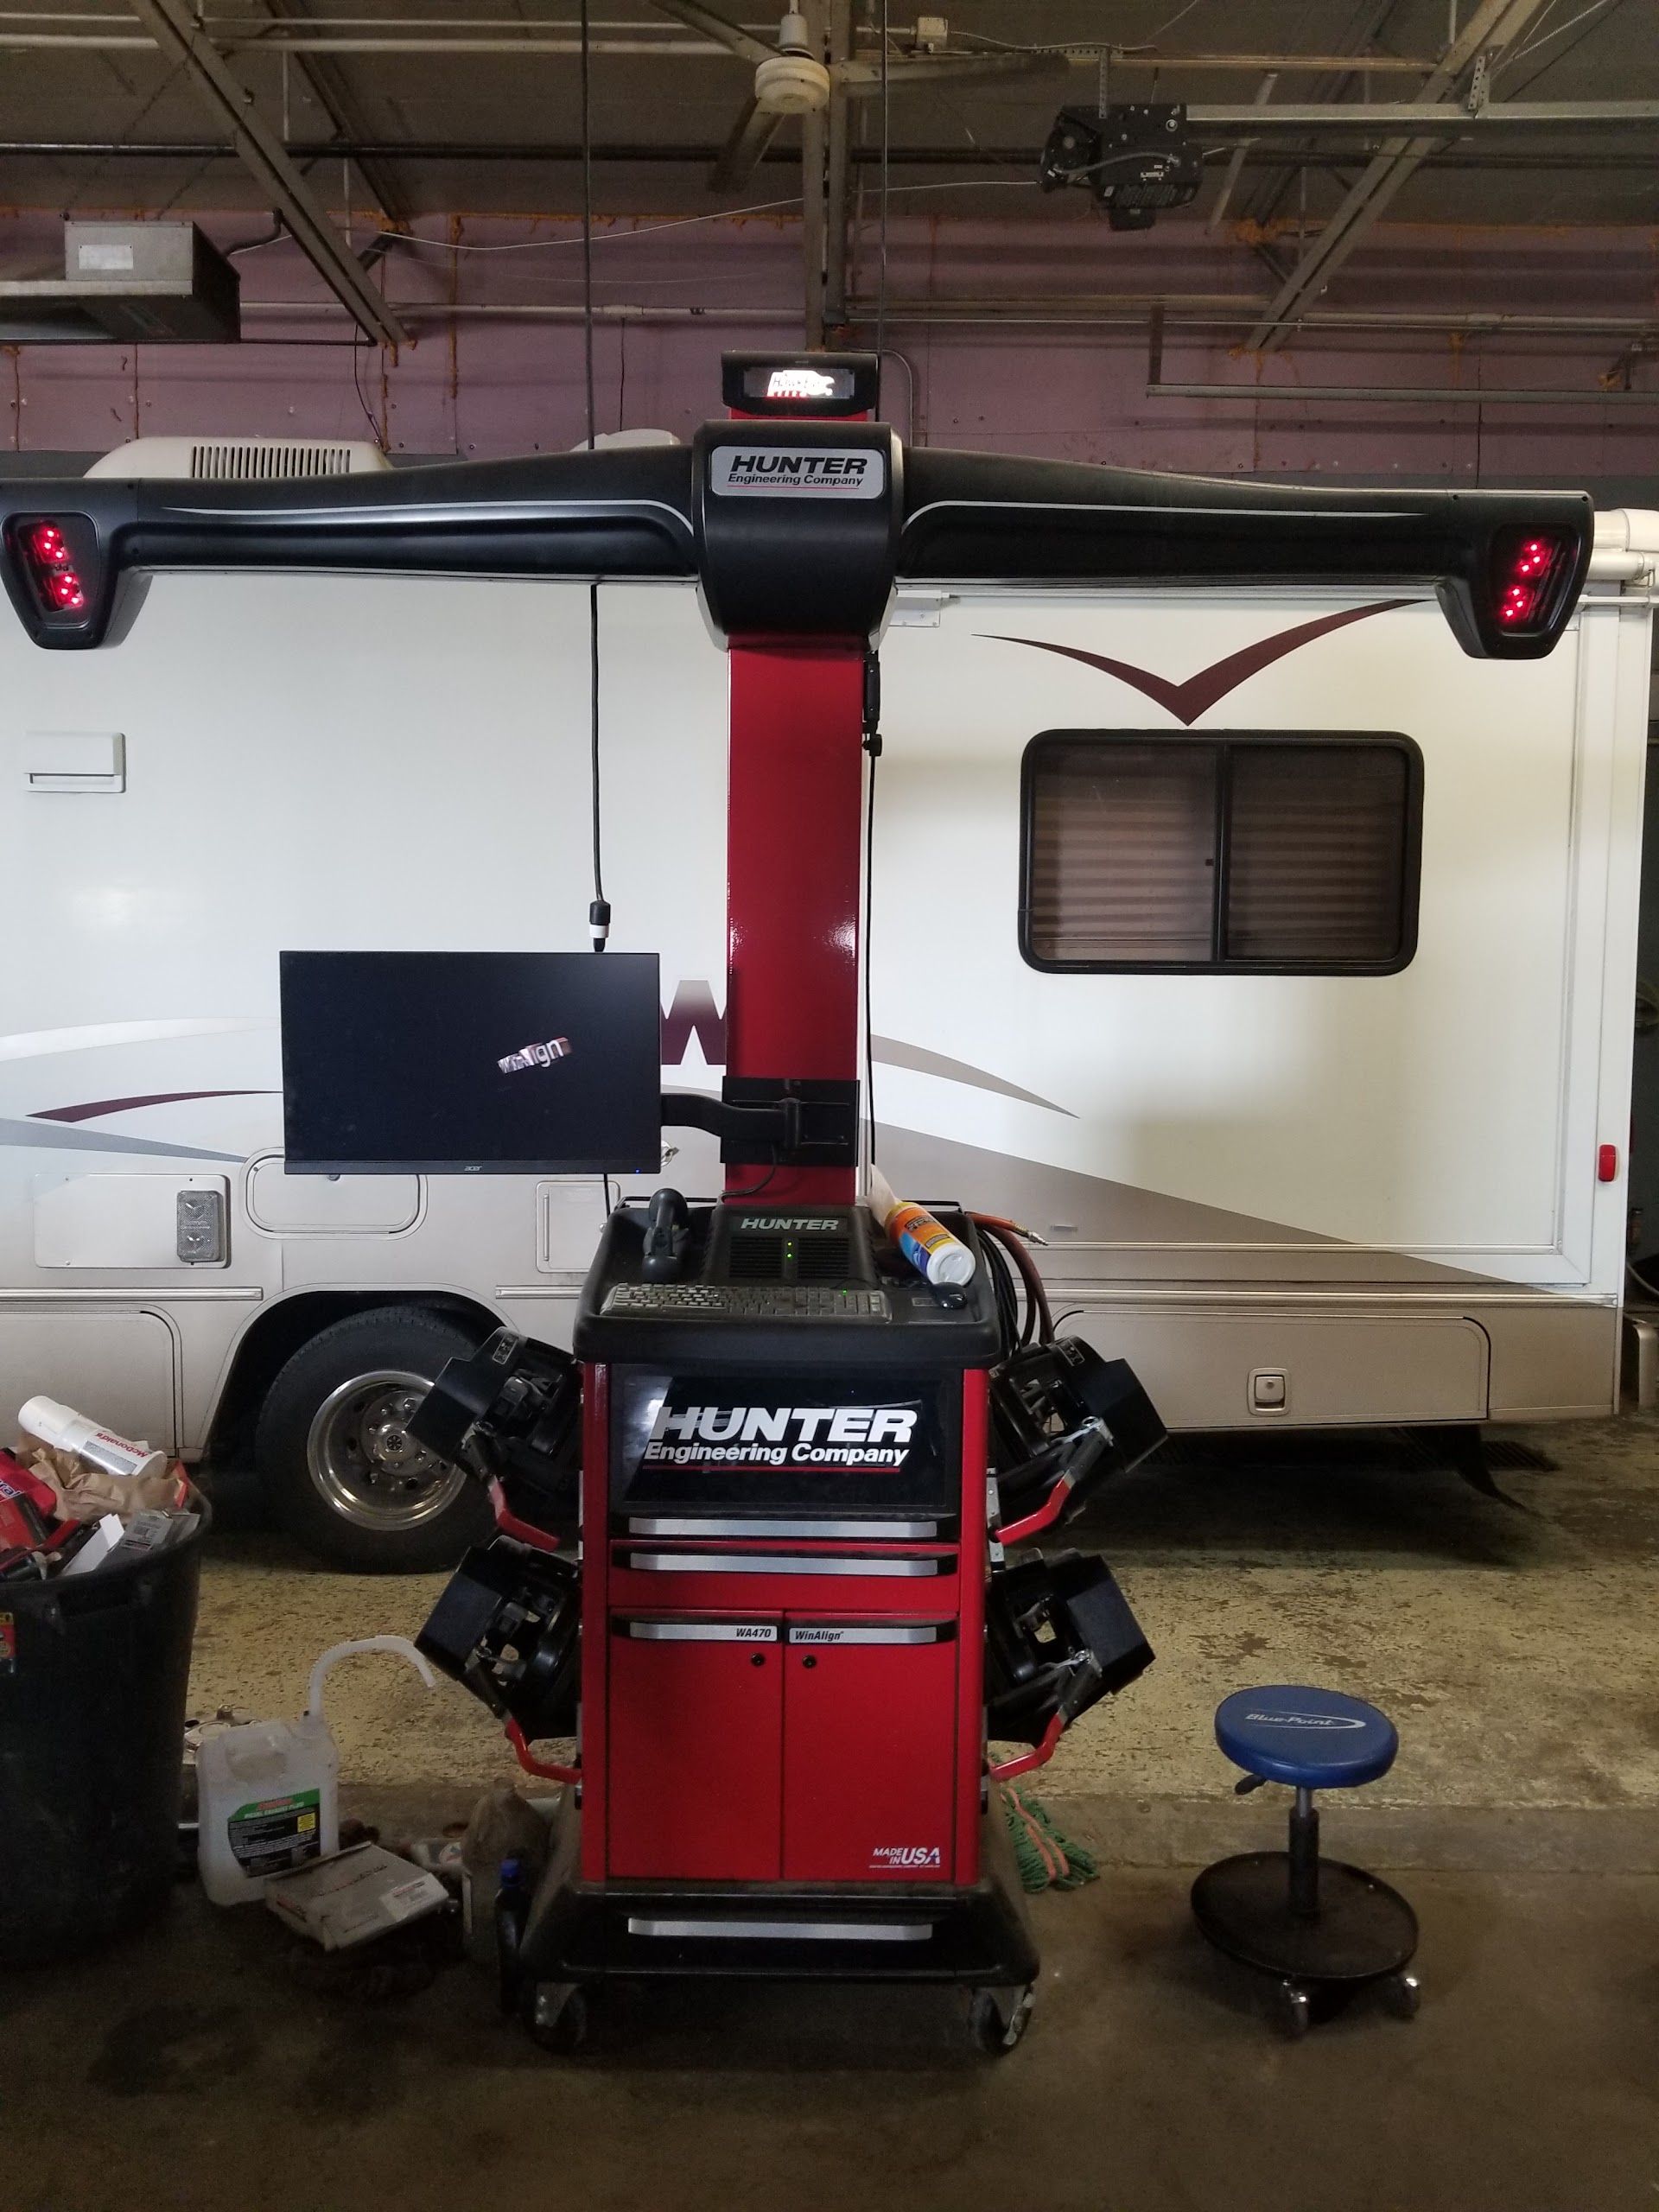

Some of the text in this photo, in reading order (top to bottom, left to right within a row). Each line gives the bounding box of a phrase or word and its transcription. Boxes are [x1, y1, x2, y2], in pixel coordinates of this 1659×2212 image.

[730, 455, 868, 474] HUNTER
[728, 474, 864, 486] Engineering Company
[741, 1217, 839, 1230] HUNTER
[650, 1407, 918, 1443] HUNTER
[95, 1432, 149, 1459] McDonald's
[644, 1442, 909, 1466] Engineering Company
[735, 1628, 772, 1638] WA470
[1244, 1713, 1334, 1726] Blue-Point
[873, 1847, 902, 1856] MADE
[900, 1847, 941, 1866] USA
[888, 1856, 901, 1865] IN
